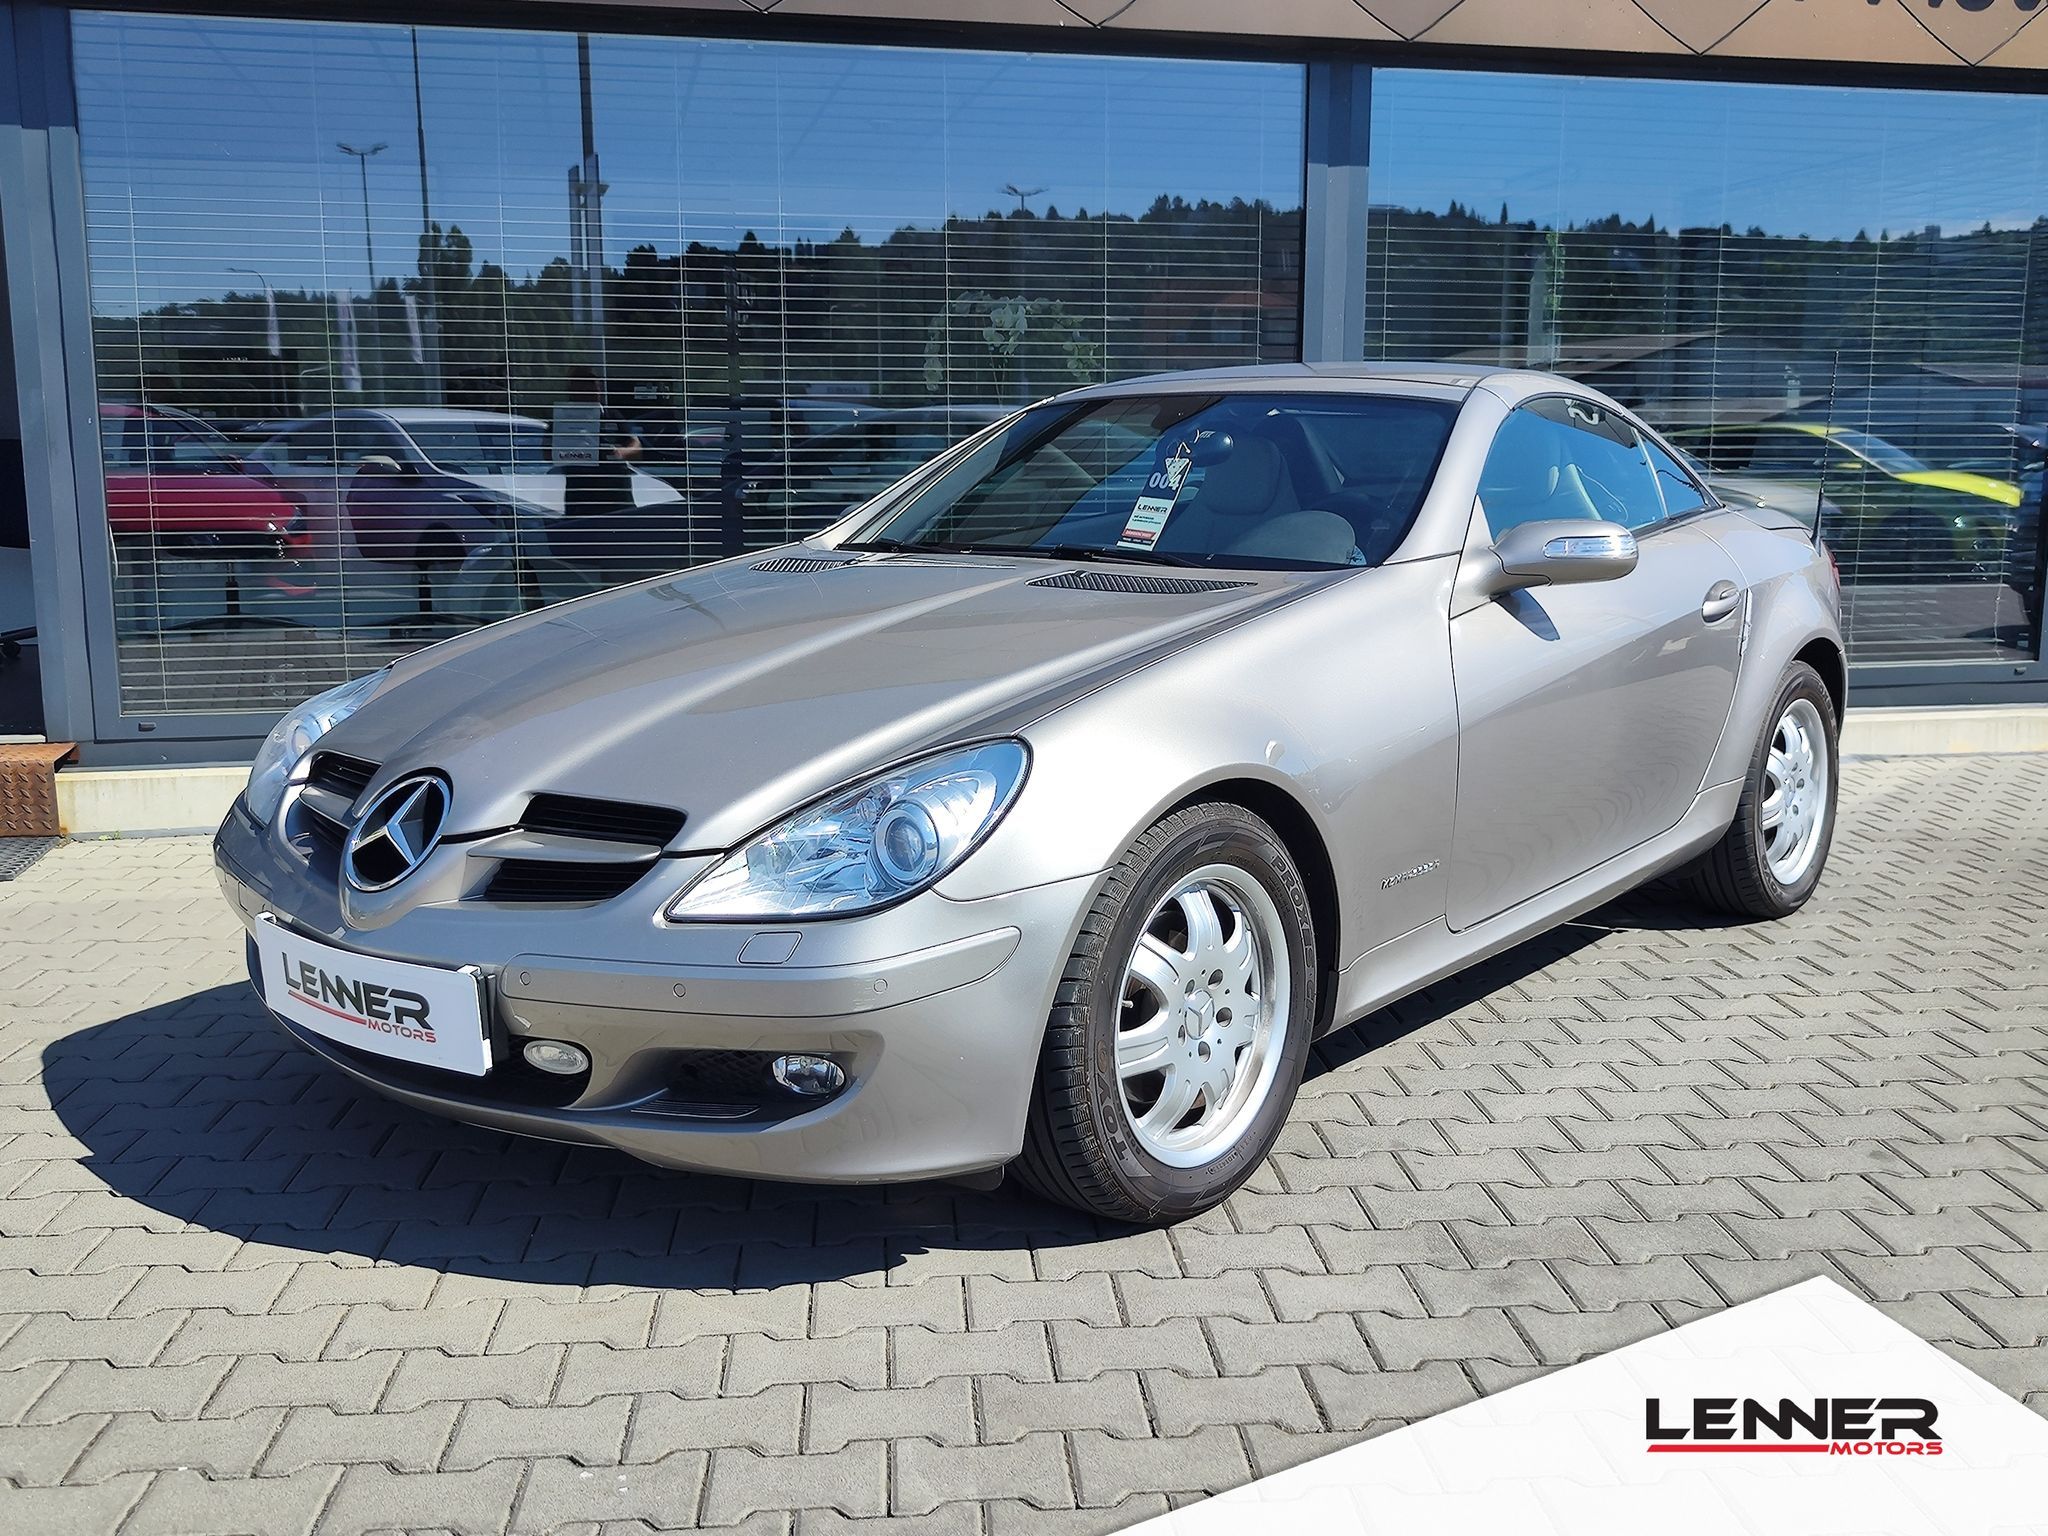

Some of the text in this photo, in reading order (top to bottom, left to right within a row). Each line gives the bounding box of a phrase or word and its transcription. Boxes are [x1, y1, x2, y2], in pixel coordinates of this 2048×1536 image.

[1138, 504, 1168, 513] LENNER
[282, 952, 433, 1030] LENNER
[367, 1018, 437, 1044] MOTORS
